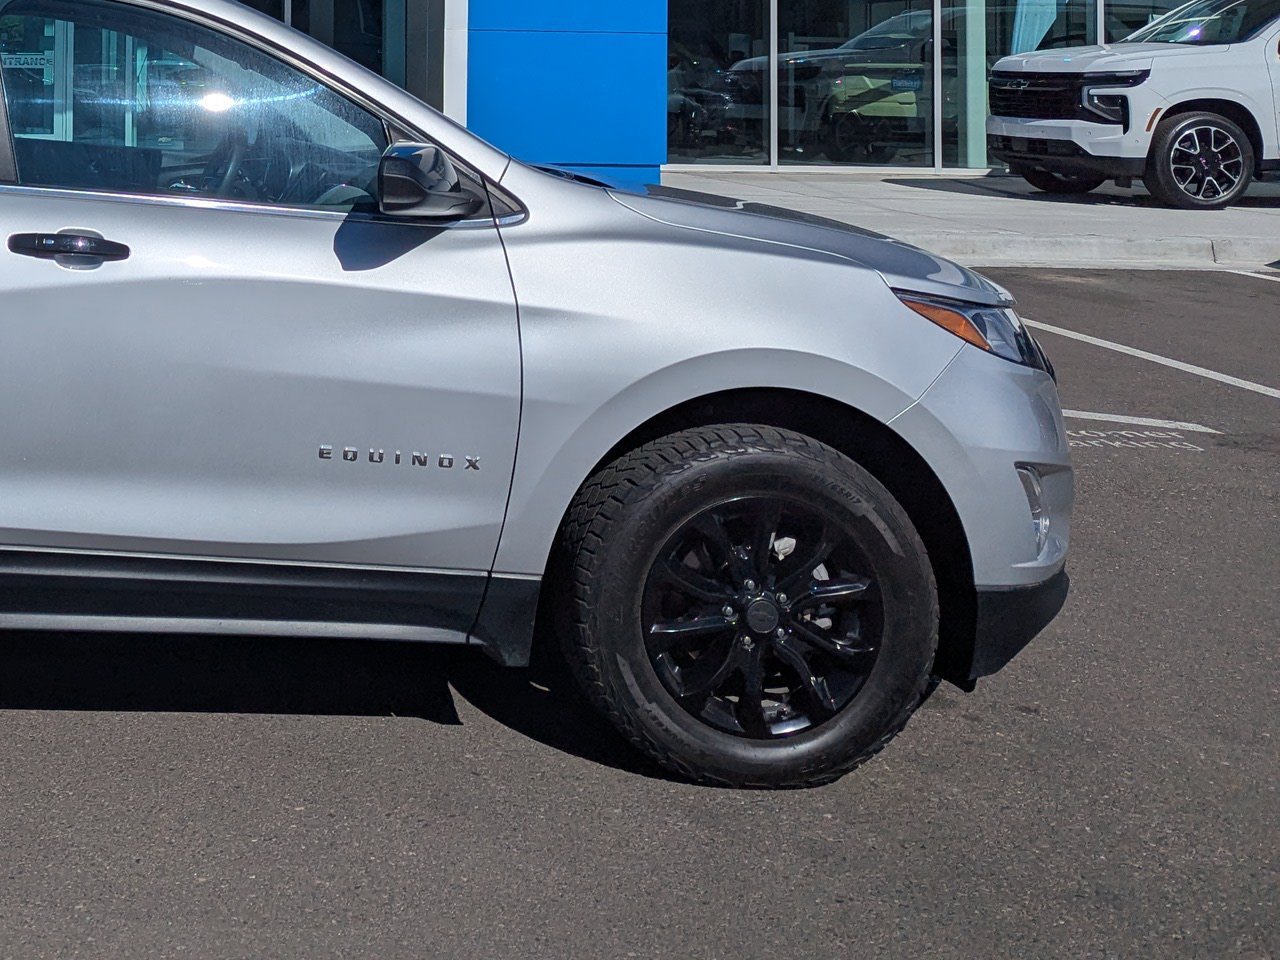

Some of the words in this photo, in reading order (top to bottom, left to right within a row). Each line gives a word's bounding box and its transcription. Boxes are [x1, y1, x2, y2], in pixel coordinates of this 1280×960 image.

[1, 57, 53, 66] NTRANCE
[1068, 439, 1205, 451] arking
[318, 444, 481, 470] EQUINOX
